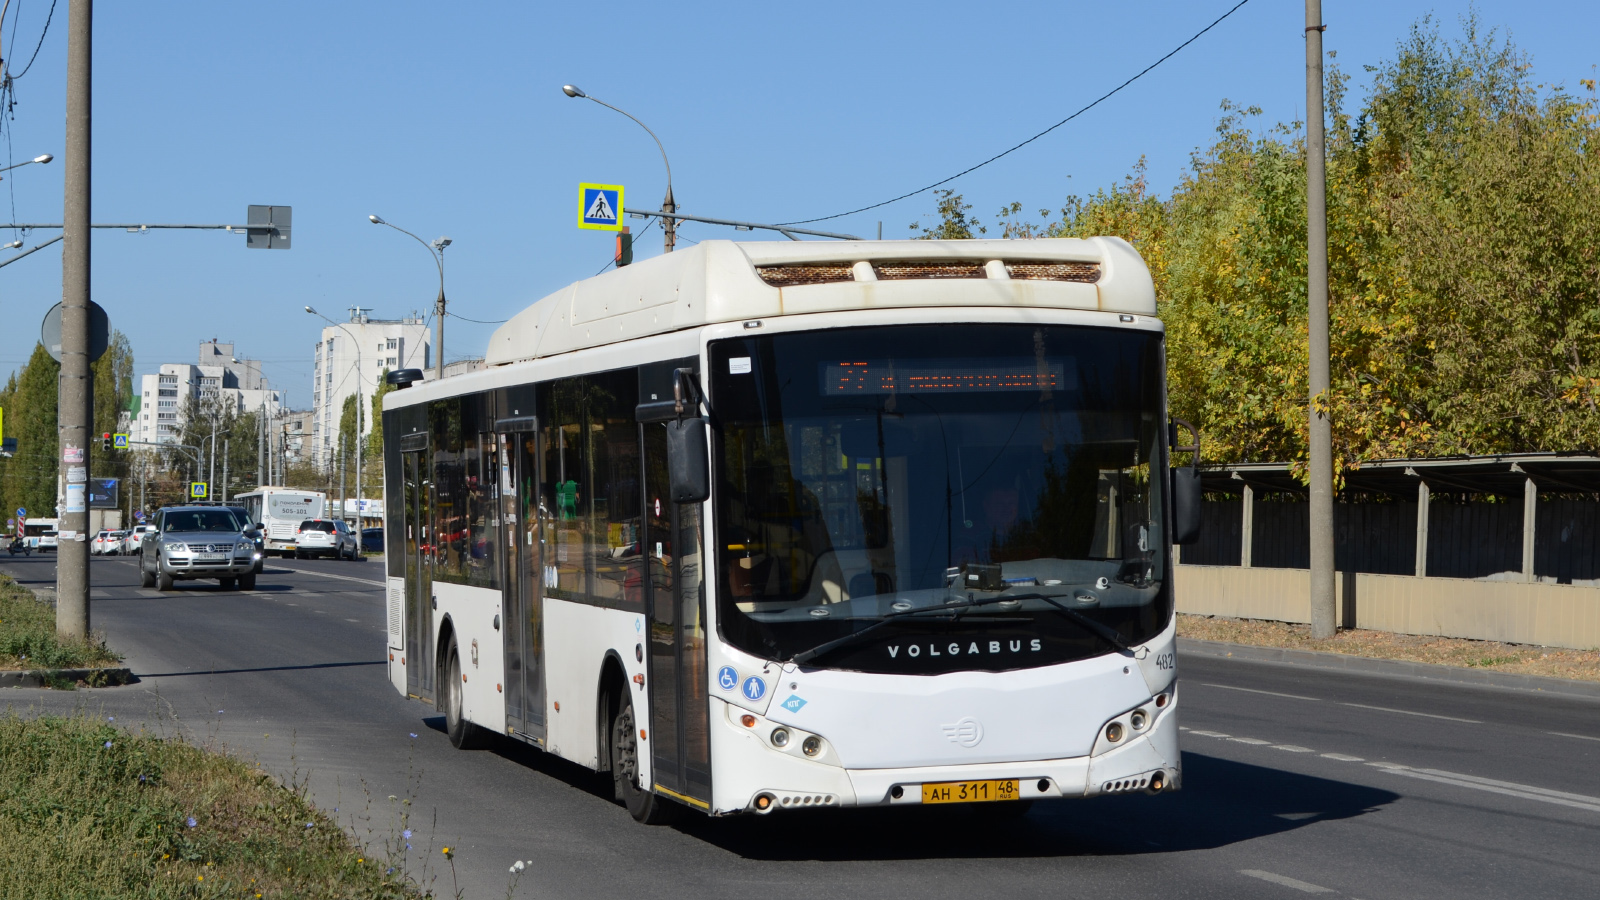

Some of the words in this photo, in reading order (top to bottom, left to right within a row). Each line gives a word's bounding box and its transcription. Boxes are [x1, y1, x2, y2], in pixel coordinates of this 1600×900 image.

[887, 638, 1042, 658] VOLGABUS
[1156, 653, 1174, 670] 482
[958, 782, 988, 800] 311
[997, 780, 1014, 794] 48
